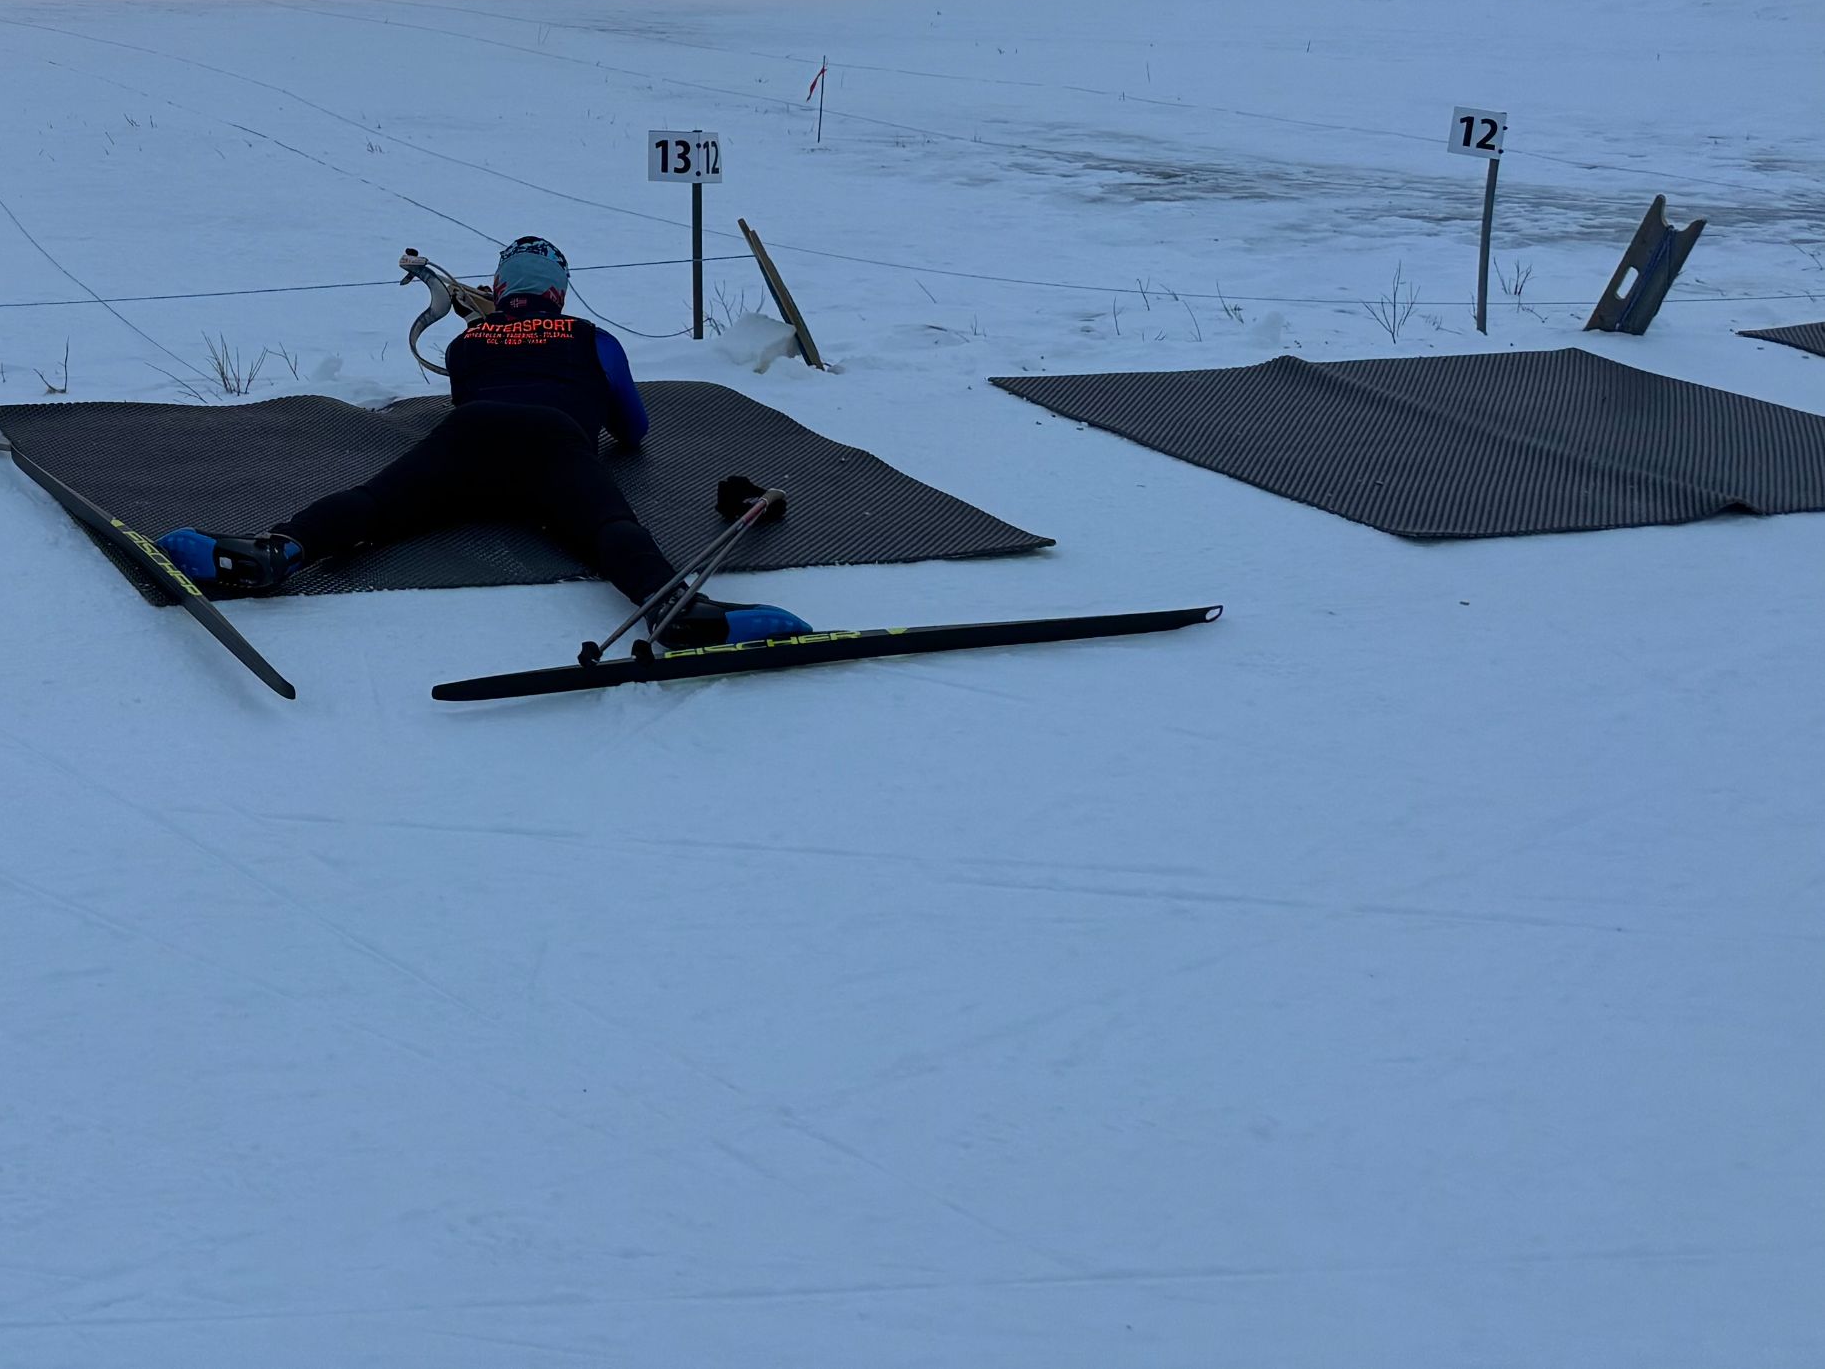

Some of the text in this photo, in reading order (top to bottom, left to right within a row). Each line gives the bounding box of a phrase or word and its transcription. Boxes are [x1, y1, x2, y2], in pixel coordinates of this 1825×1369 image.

[1459, 116, 1498, 151] 12
[655, 139, 720, 175] 13 12
[122, 530, 204, 597] FISCHER
[663, 630, 862, 660] FISCHER
